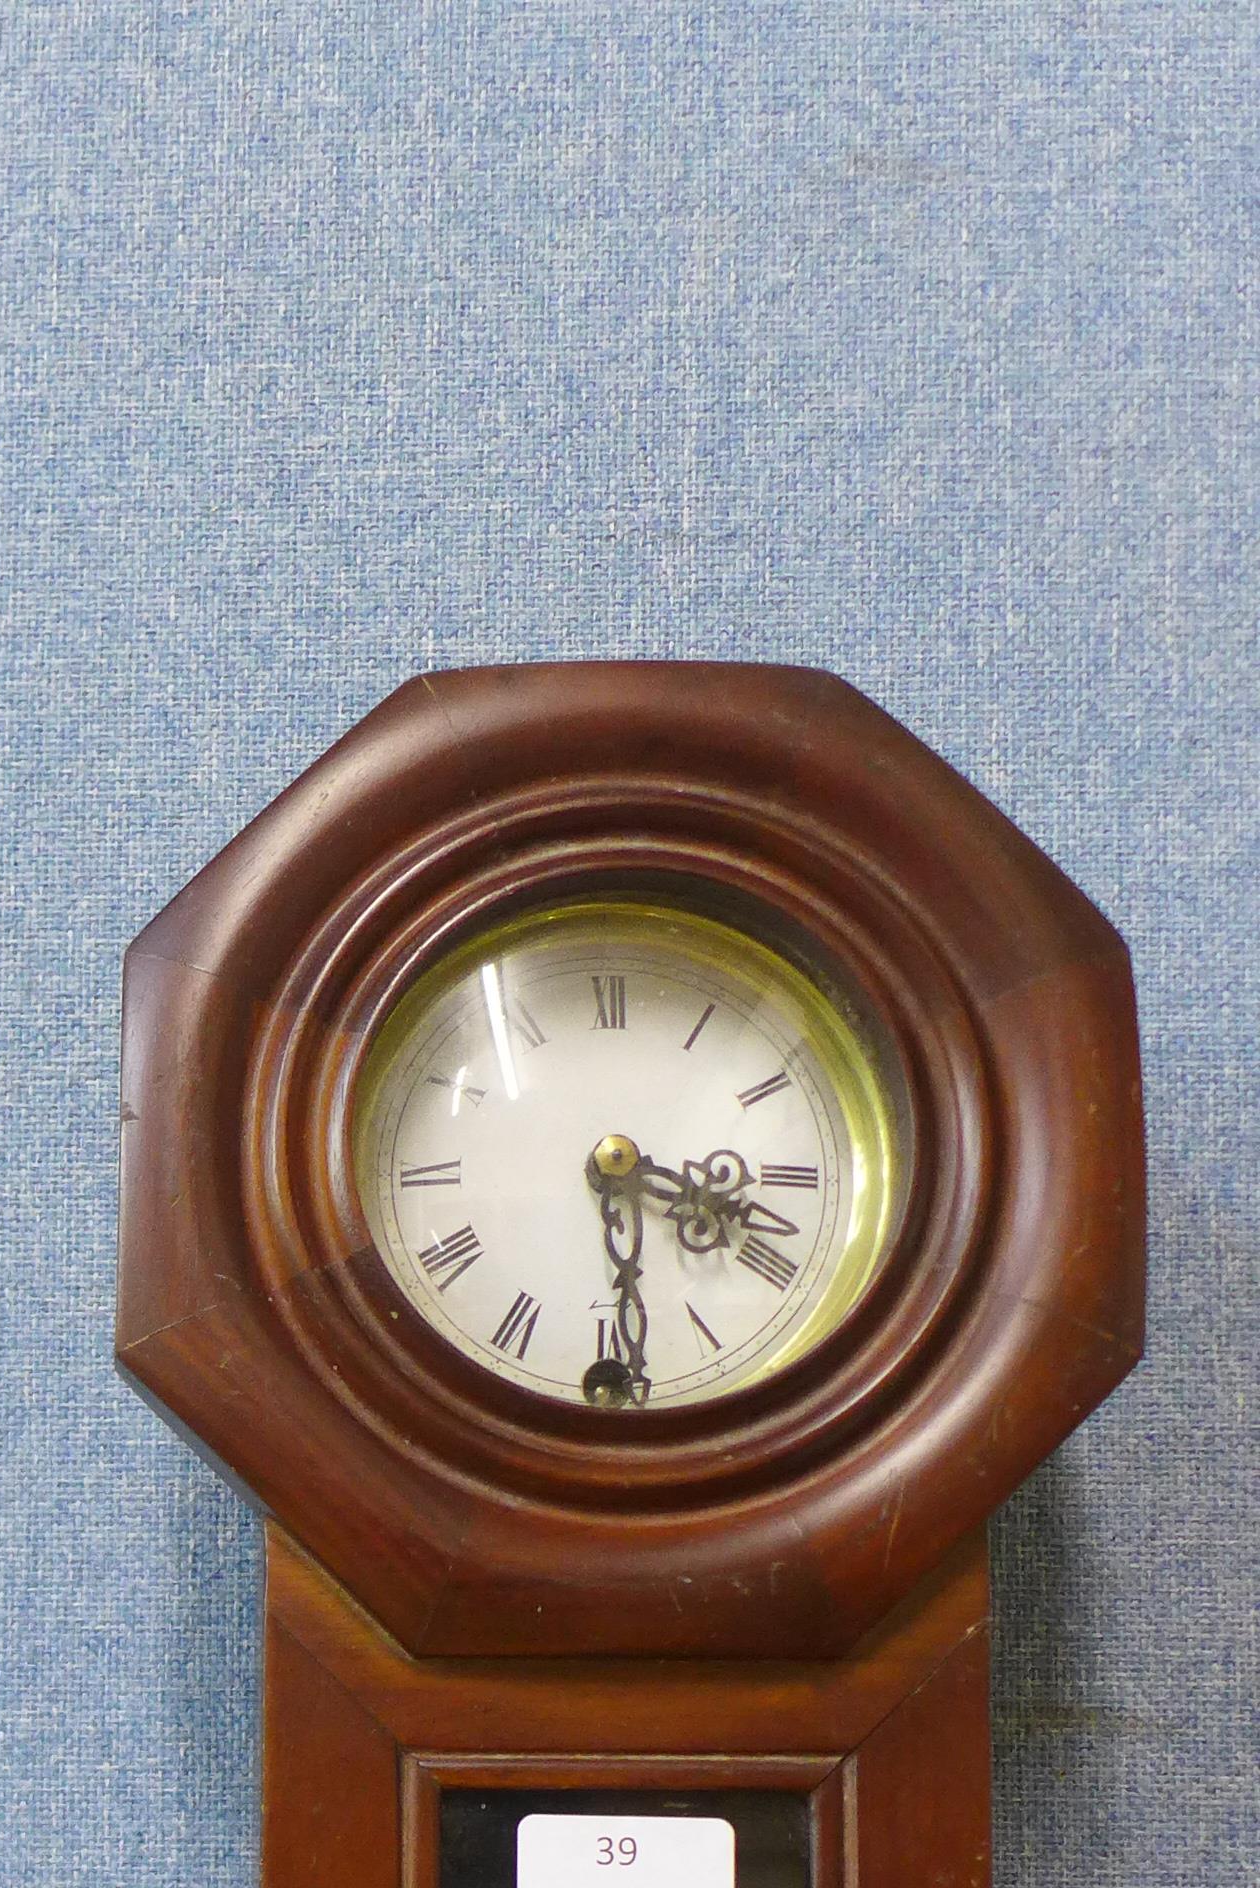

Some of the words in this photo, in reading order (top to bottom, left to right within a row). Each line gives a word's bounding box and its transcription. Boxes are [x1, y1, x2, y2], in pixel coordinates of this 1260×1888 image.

[592, 976, 625, 1029] XII
[400, 1158, 461, 1189] IX
[760, 1165, 818, 1189] III
[417, 1223, 483, 1294] VIII
[737, 1235, 798, 1293] IIII
[490, 1291, 542, 1360] VII
[596, 1836, 637, 1866] 39
